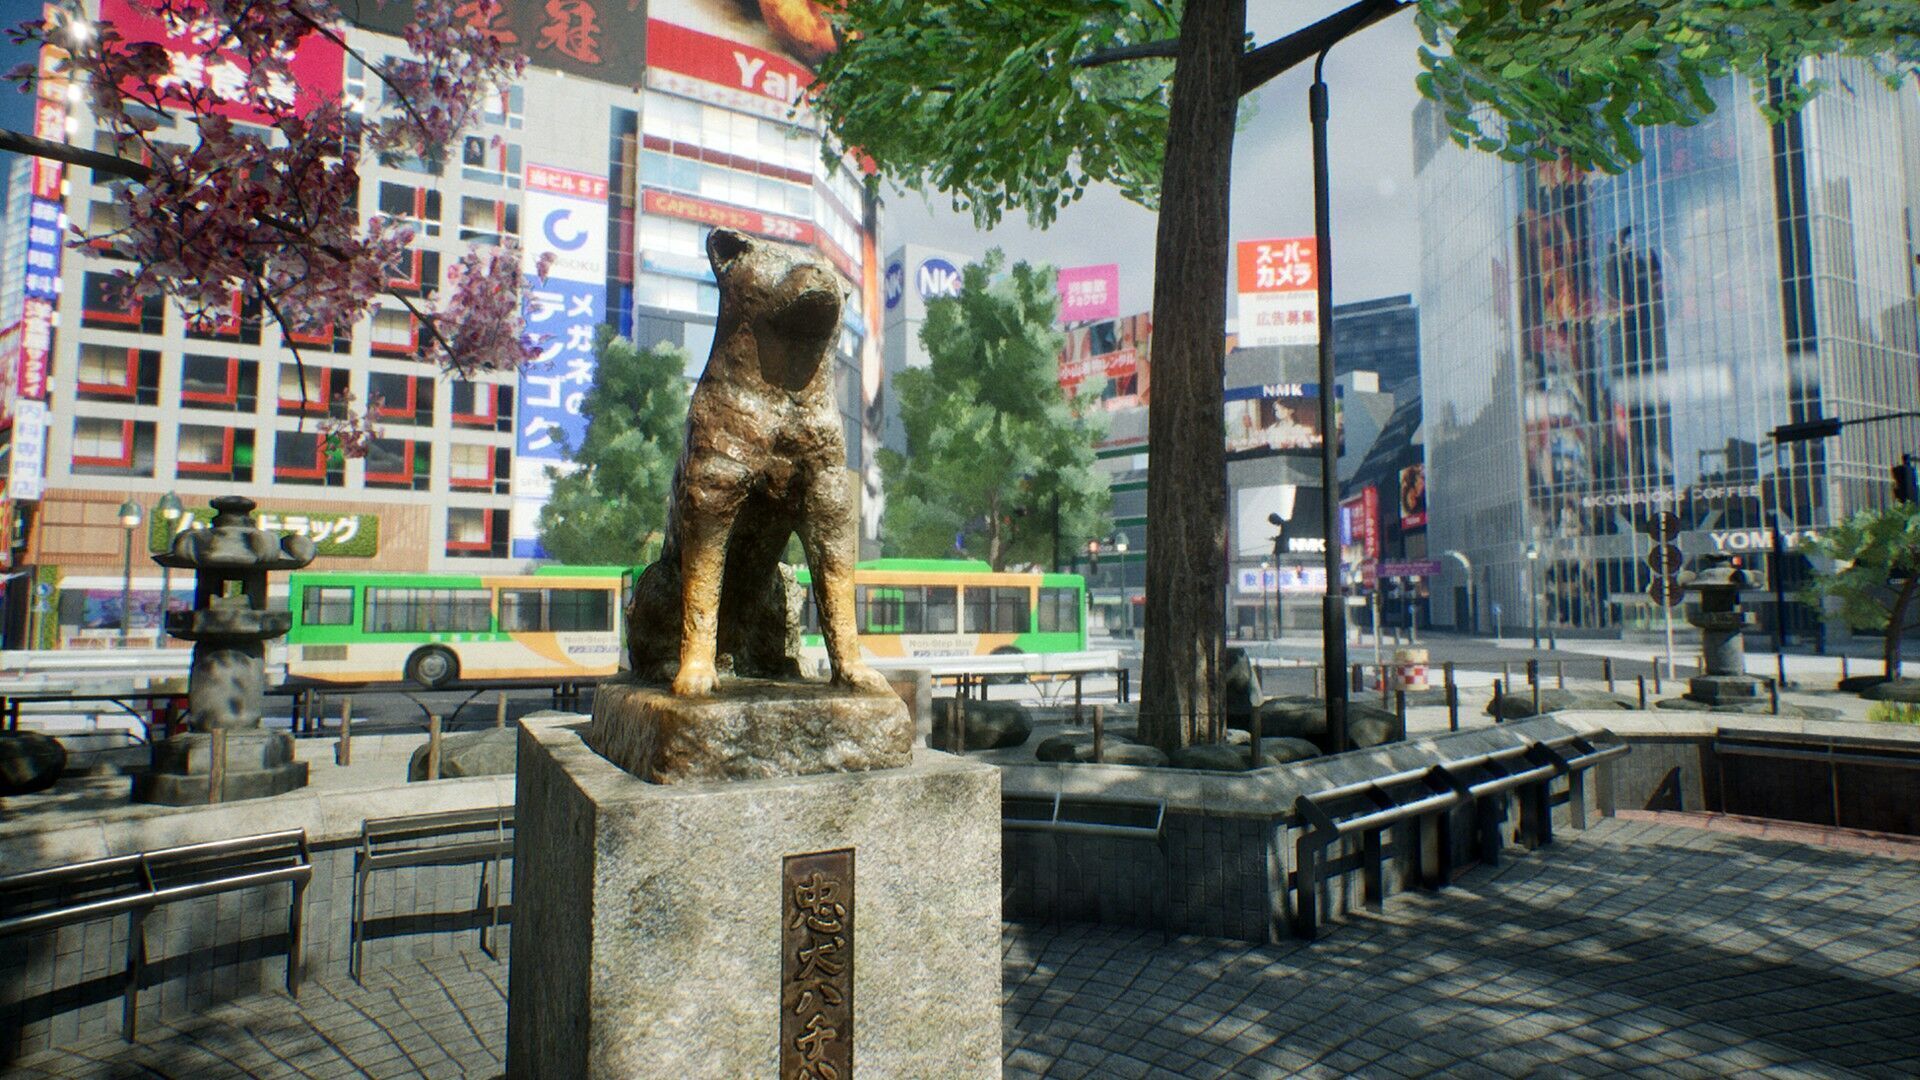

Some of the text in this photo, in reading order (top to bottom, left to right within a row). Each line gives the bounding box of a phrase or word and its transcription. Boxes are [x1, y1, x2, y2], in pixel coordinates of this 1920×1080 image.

[1256, 241, 1311, 264] スーパー
[1256, 262, 1312, 288] カメラ
[1256, 309, 1315, 326] 広告募集
[565, 293, 594, 415] メガネの
[1263, 383, 1303, 397] NMK
[1289, 538, 1326, 552] NMK
